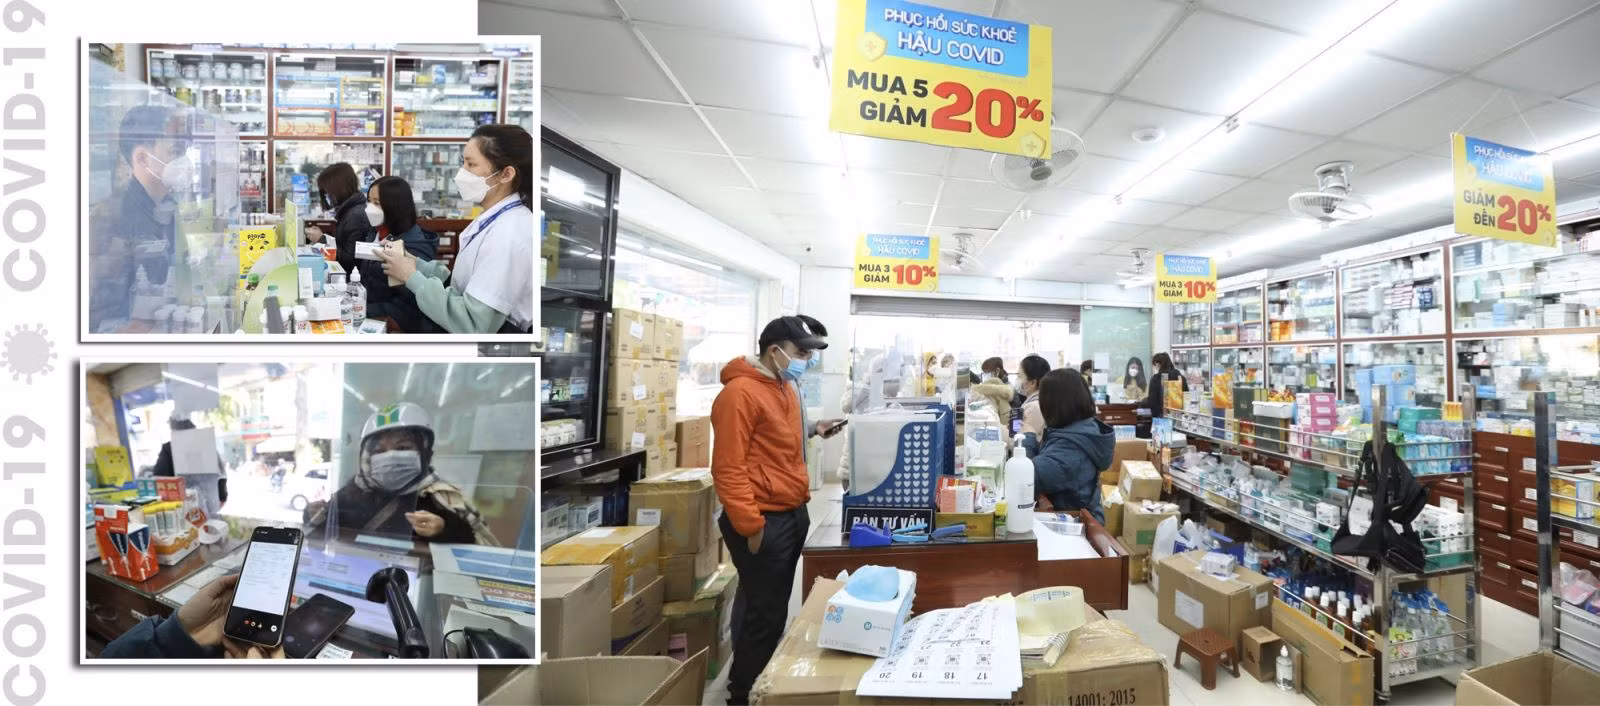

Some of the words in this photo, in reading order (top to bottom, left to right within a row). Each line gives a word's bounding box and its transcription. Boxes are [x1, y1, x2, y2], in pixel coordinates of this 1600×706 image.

[884, 8, 923, 27] PHỤC
[926, 15, 948, 31] HỒI
[951, 19, 978, 37] SỨC
[981, 25, 1017, 43] KHOẺ
[897, 31, 941, 57] HẬU
[947, 40, 1005, 65] COVID
[847, 69, 908, 96] MUA
[913, 79, 928, 98] 5
[859, 97, 927, 127] GIẢM
[931, 81, 1044, 138] 20%
[1464, 188, 1495, 208] GIẢM
[1473, 208, 1496, 227] ĐẾN
[1497, 194, 1552, 235] 20%
[859, 263, 881, 273] MUA
[884, 264, 890, 273] 3
[863, 272, 890, 283] GIẢM
[892, 264, 937, 286] 10%
[1159, 280, 1177, 288] MUA
[1184, 280, 1216, 299] 10%
[879, 671, 892, 679] 20
[911, 671, 923, 679] 19
[944, 671, 955, 679] 18
[976, 671, 988, 680] 17
[1109, 688, 1136, 705] 2015
